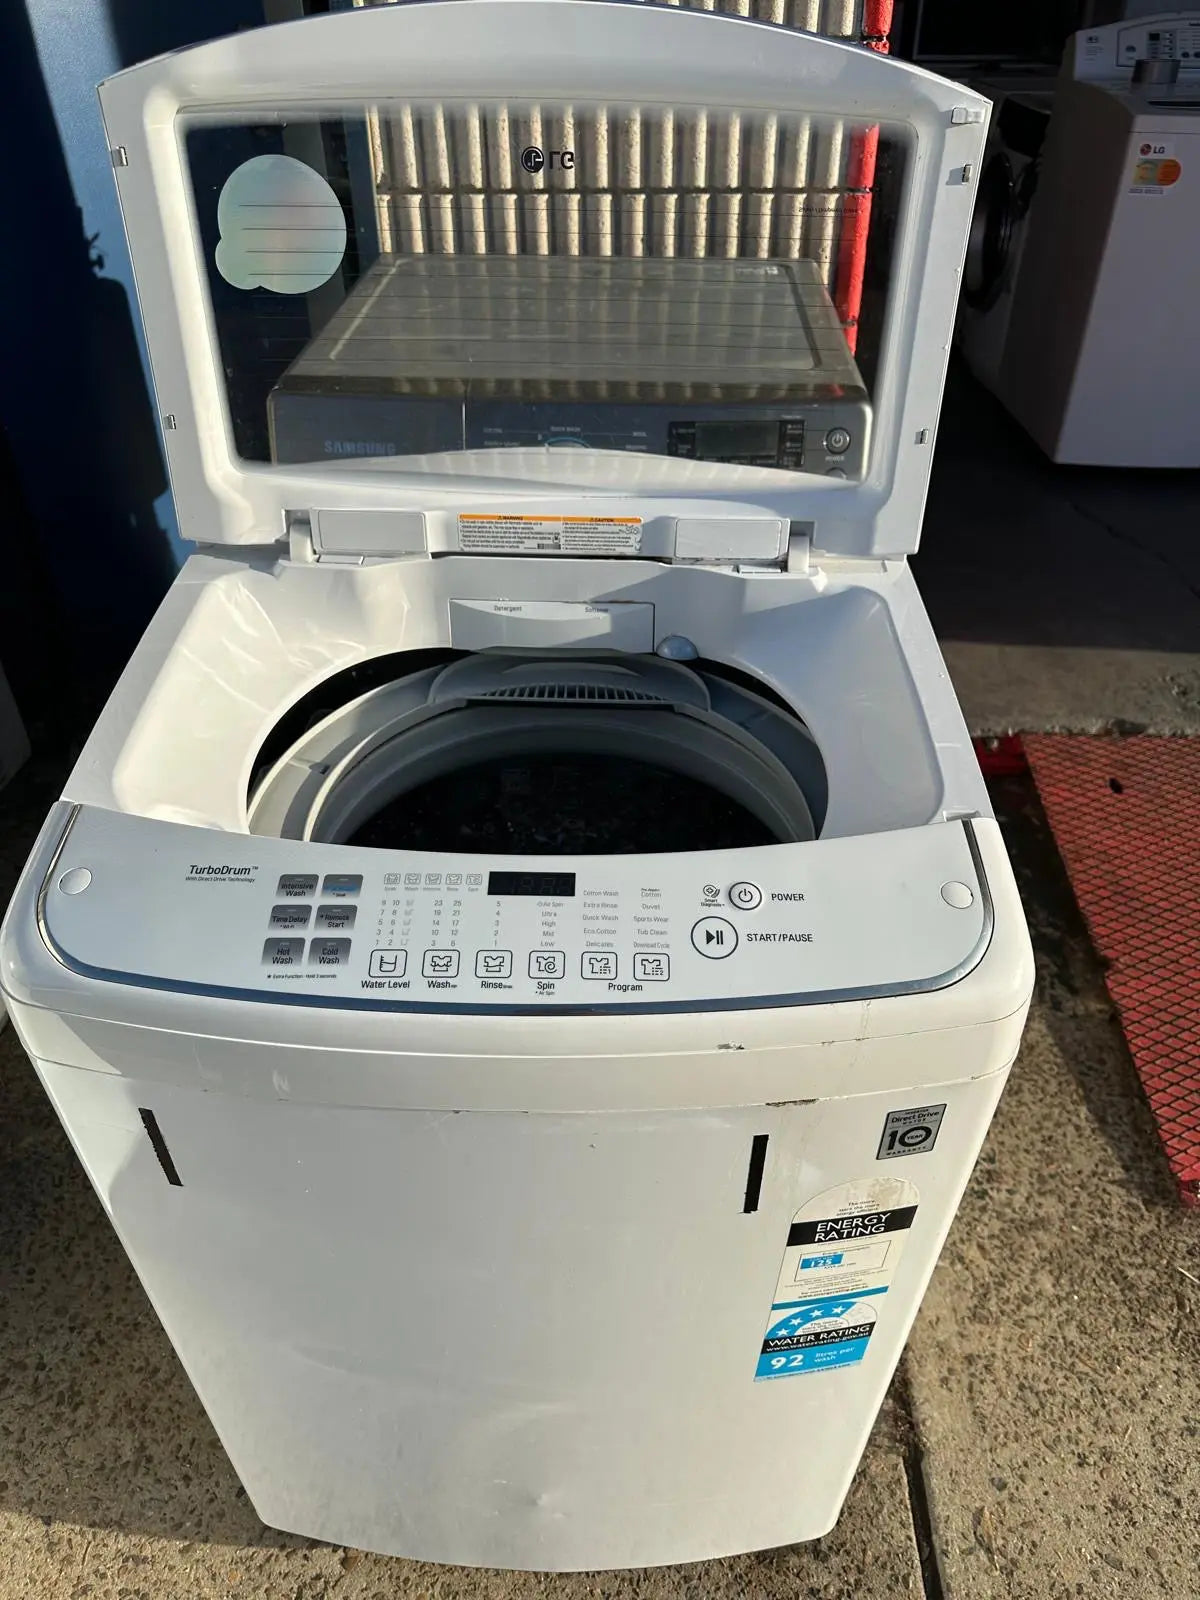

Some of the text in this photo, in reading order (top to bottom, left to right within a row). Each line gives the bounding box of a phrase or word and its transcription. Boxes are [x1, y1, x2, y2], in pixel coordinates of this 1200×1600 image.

[1153, 146, 1165, 154] LG
[324, 440, 395, 456] SAMSUNG
[771, 893, 804, 902] POWER
[272, 915, 307, 924] Time Delay
[746, 933, 813, 943] START/PAUSE
[277, 948, 291, 956] Hot
[322, 948, 339, 956] Cold
[272, 956, 293, 964] Wash
[319, 956, 339, 964] Wash
[361, 980, 411, 989] Water Level
[427, 980, 451, 989] Wash
[480, 980, 503, 989] Rinse
[537, 981, 555, 990] Spin
[608, 982, 643, 992] Program
[891, 1111, 940, 1123] Direct Drive
[886, 1146, 926, 1156] WARRANTY
[816, 1212, 891, 1232] ENERGY
[814, 1223, 885, 1242] RATING
[810, 1258, 833, 1268] 125
[768, 1335, 816, 1347] WATER
[819, 1324, 871, 1342] RATING
[815, 1346, 856, 1358] litres per
[770, 1354, 804, 1370] 92
